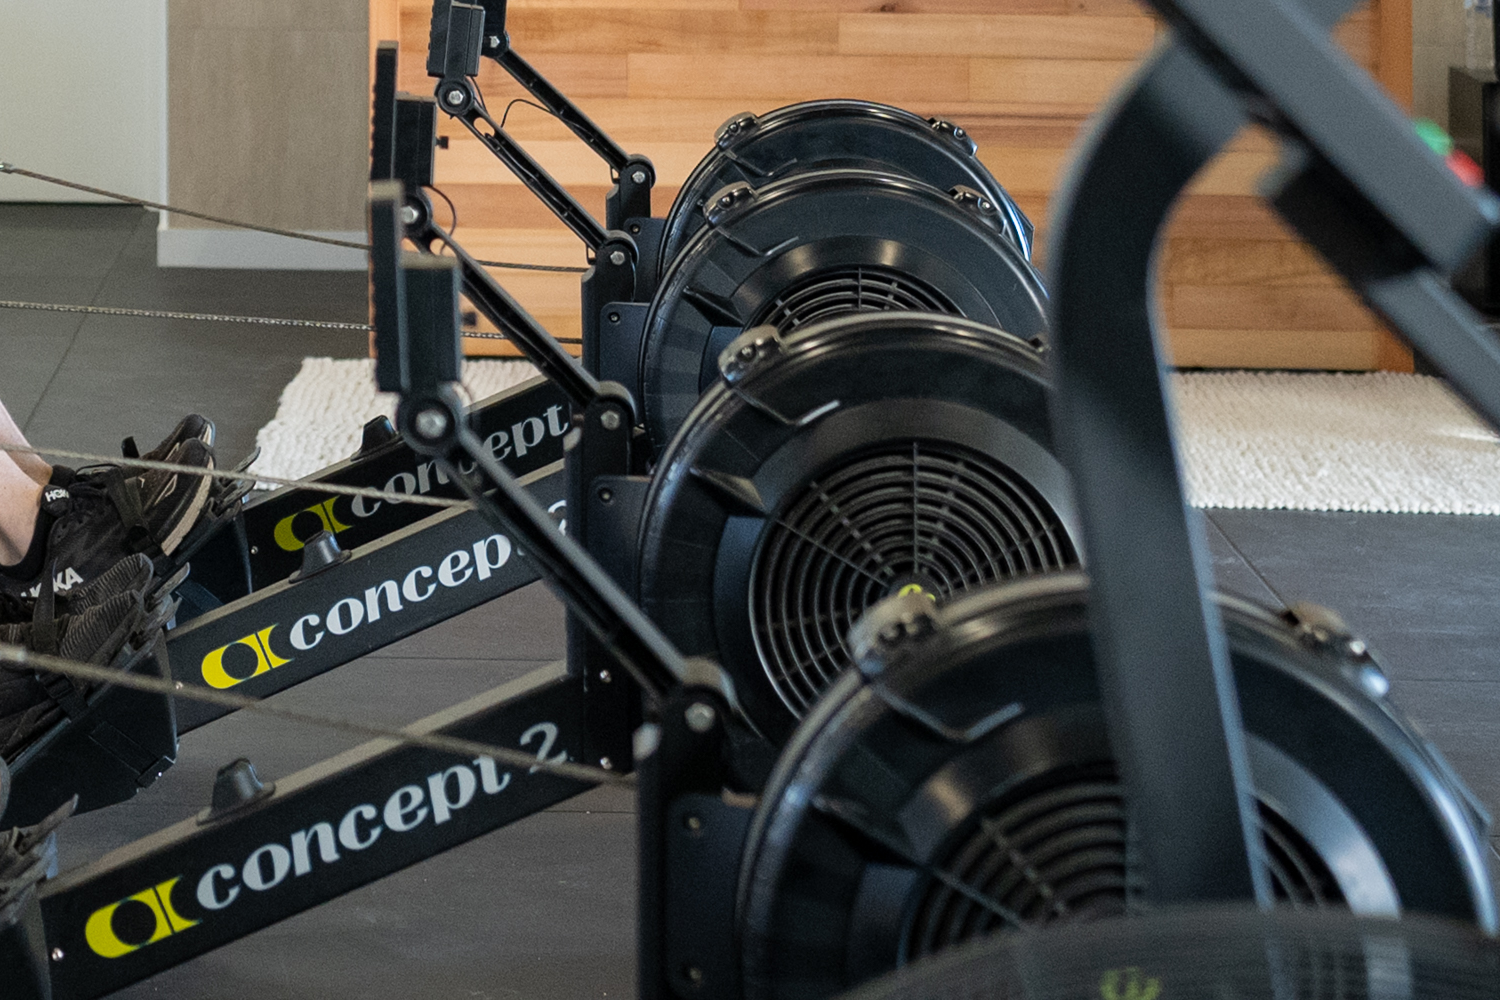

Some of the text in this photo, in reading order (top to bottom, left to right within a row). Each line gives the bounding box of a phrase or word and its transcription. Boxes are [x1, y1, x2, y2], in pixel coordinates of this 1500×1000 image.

[290, 530, 527, 650] concep
[196, 722, 567, 911] concept 2
